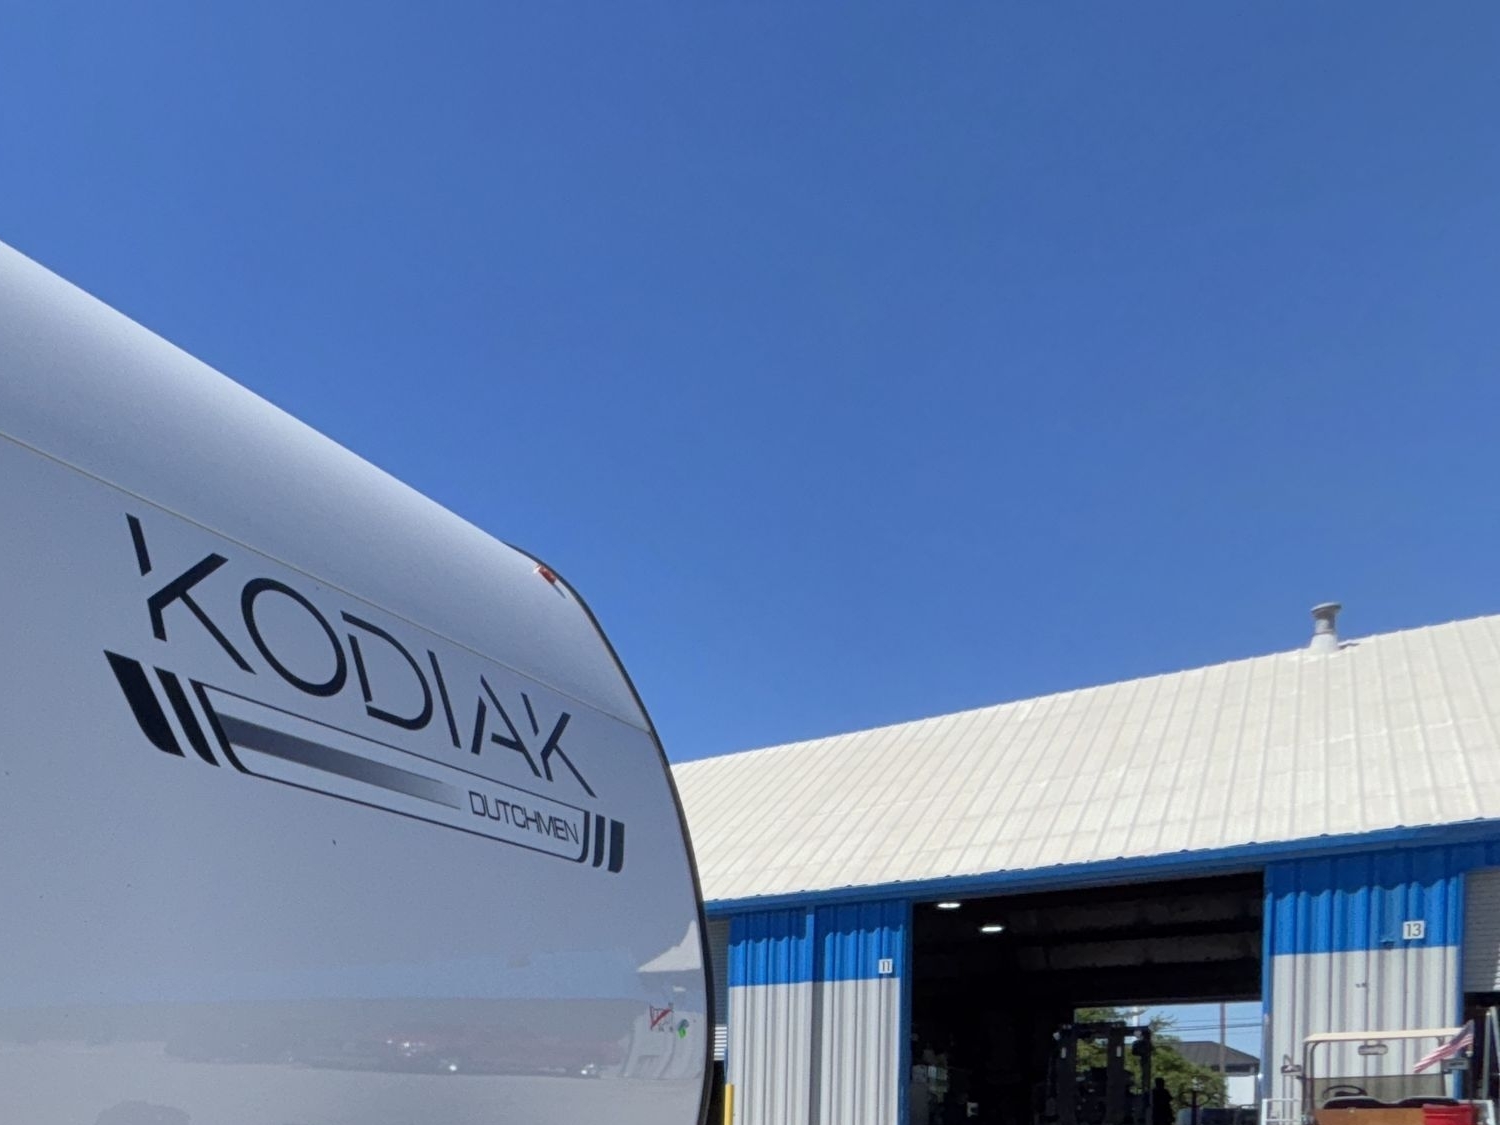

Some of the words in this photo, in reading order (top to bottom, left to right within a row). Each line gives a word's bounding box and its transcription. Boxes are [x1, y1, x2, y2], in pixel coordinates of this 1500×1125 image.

[125, 513, 597, 798] KODIAK
[468, 790, 580, 845] DUTCHMEN
[1406, 923, 1422, 937] 13
